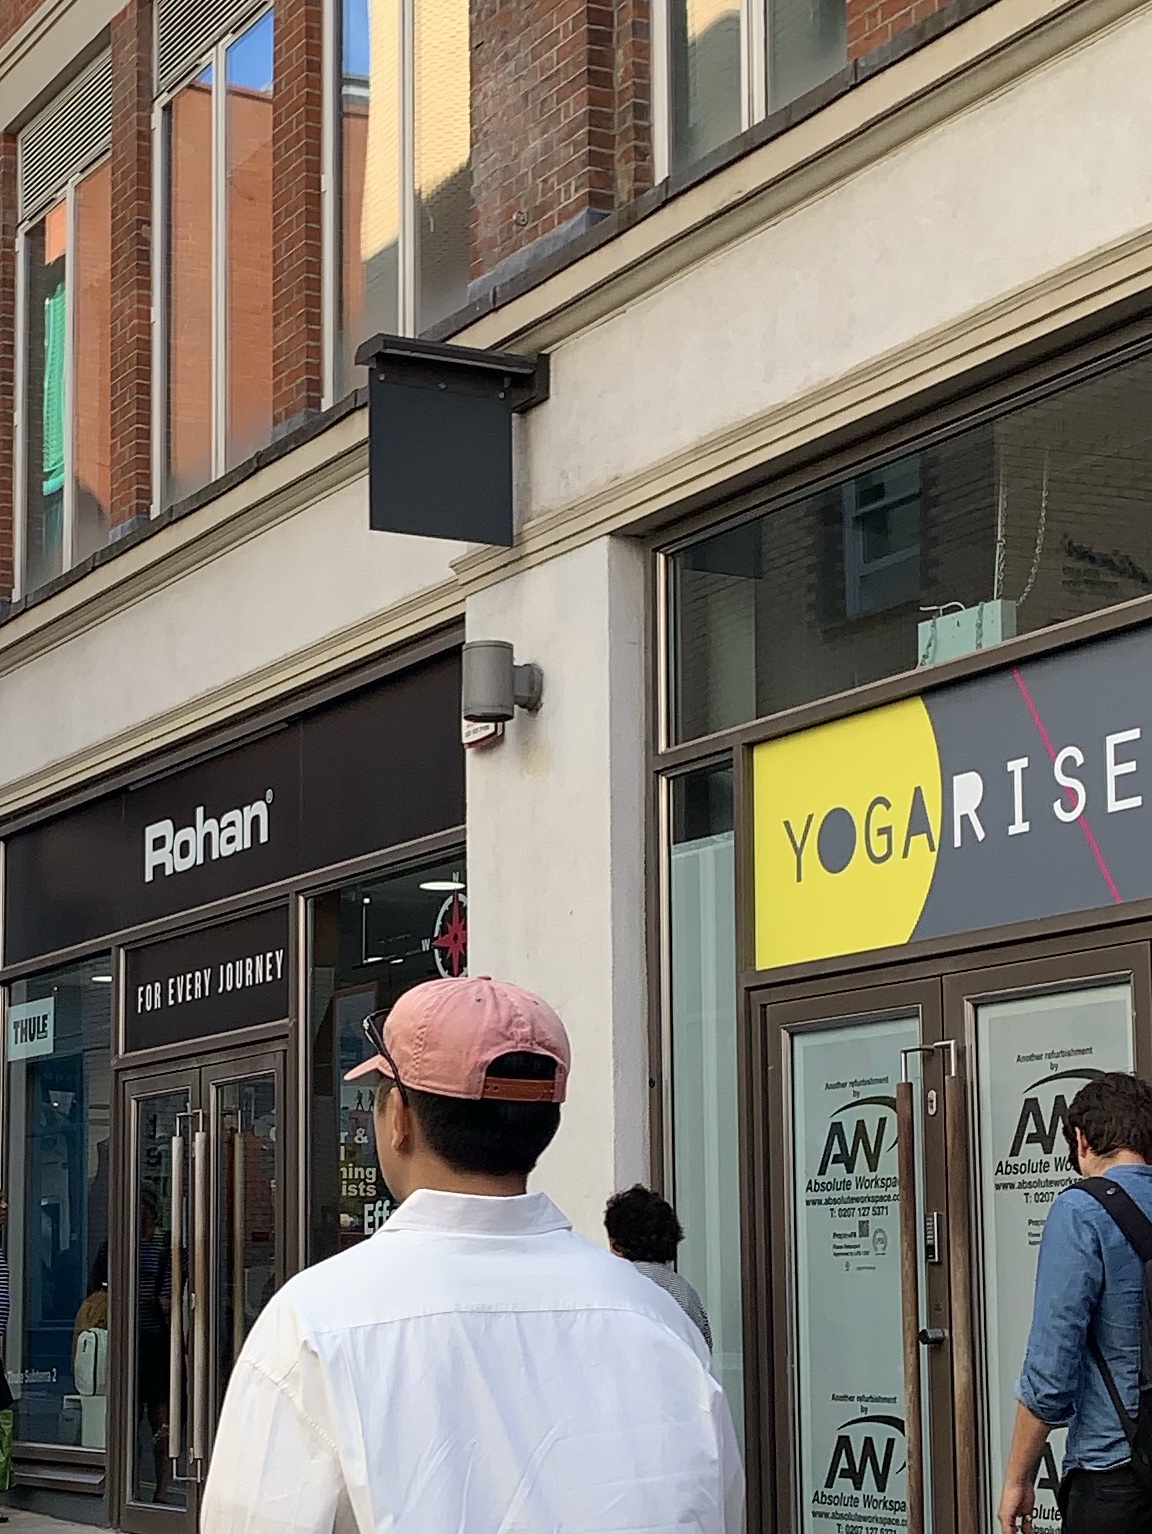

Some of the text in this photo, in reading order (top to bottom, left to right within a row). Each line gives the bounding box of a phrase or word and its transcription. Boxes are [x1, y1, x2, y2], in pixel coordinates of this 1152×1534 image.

[137, 948, 284, 1014] FOR EVERY JOURNEY
[12, 1013, 49, 1046] THULE
[817, 1116, 888, 1177] AW
[994, 1155, 1072, 1177] Absolute Wo
[341, 1180, 377, 1197] ists
[805, 1174, 899, 1193] Absolute Workspa
[994, 1177, 1082, 1191] www.absoluteworks
[1034, 1191, 1055, 1203] 0207
[364, 1199, 396, 1236] Eff
[829, 1205, 889, 1218] T: 0207 127 5371
[824, 1435, 896, 1493] AW
[811, 1490, 907, 1515] Absolute Workspa
[1032, 1504, 1062, 1521] olute
[836, 1523, 844, 1534] T:
